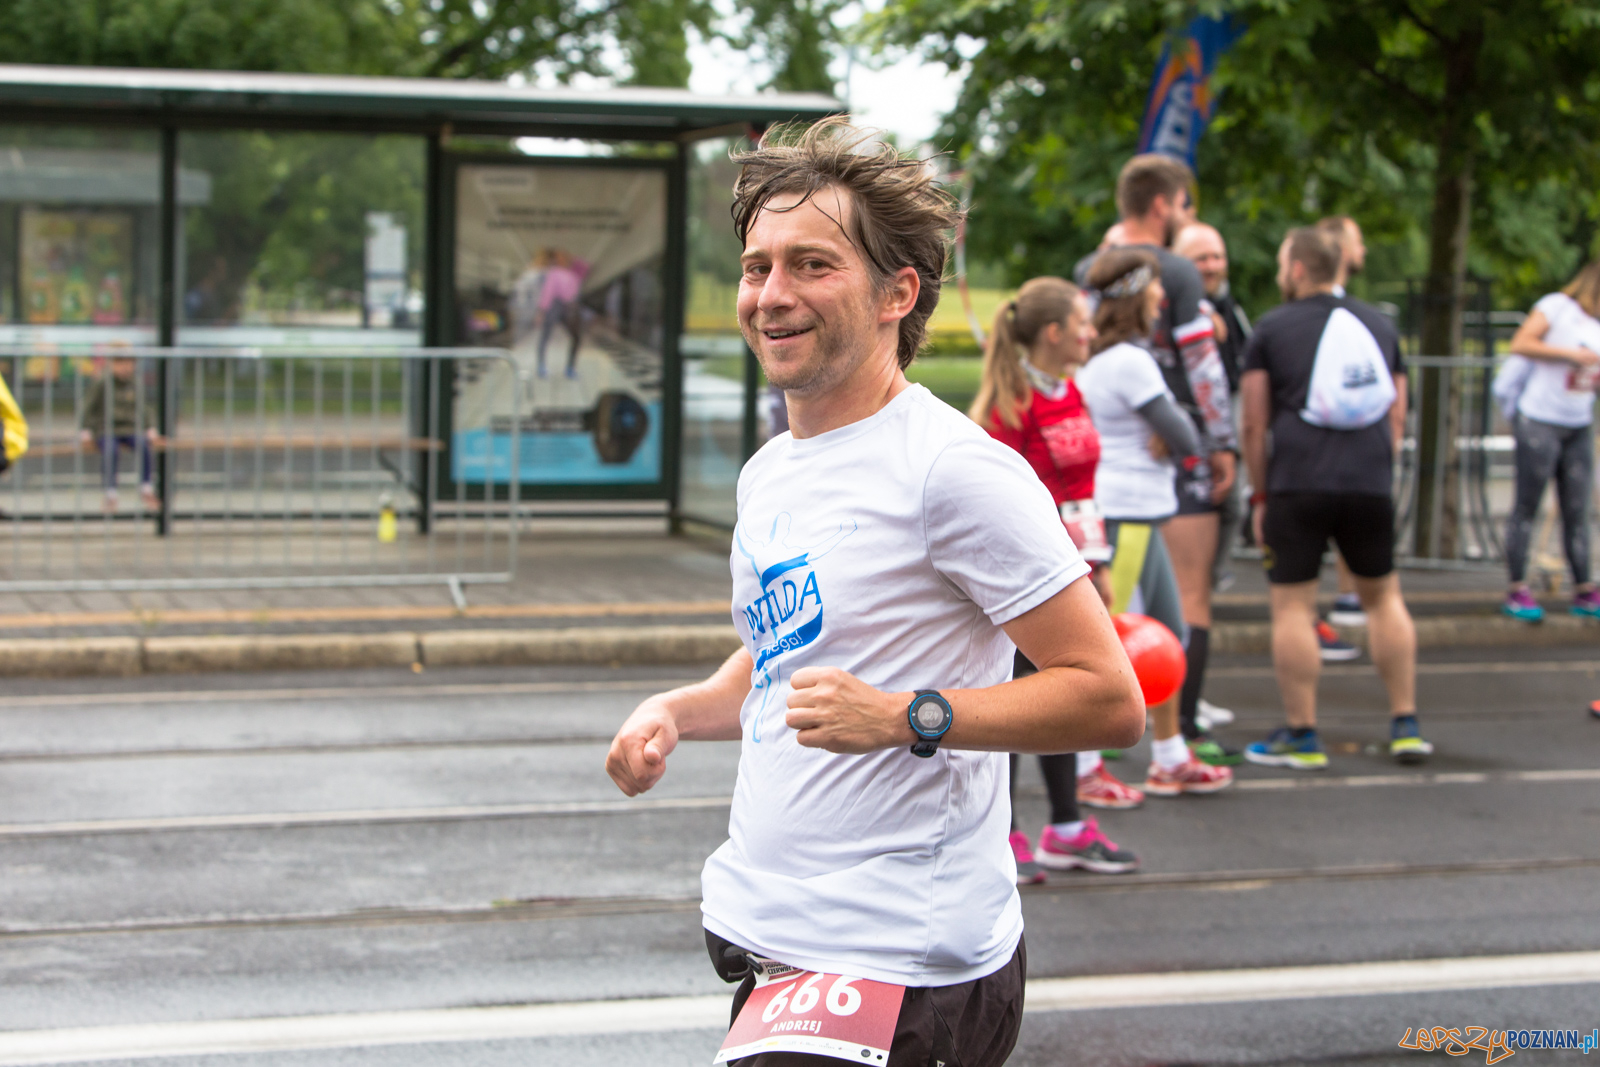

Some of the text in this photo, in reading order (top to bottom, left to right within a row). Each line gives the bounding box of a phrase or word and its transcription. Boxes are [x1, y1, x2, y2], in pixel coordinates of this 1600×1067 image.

[743, 570, 823, 641] WILDA
[761, 972, 863, 1024] 666
[770, 1019, 823, 1035] ANDRZEJ
